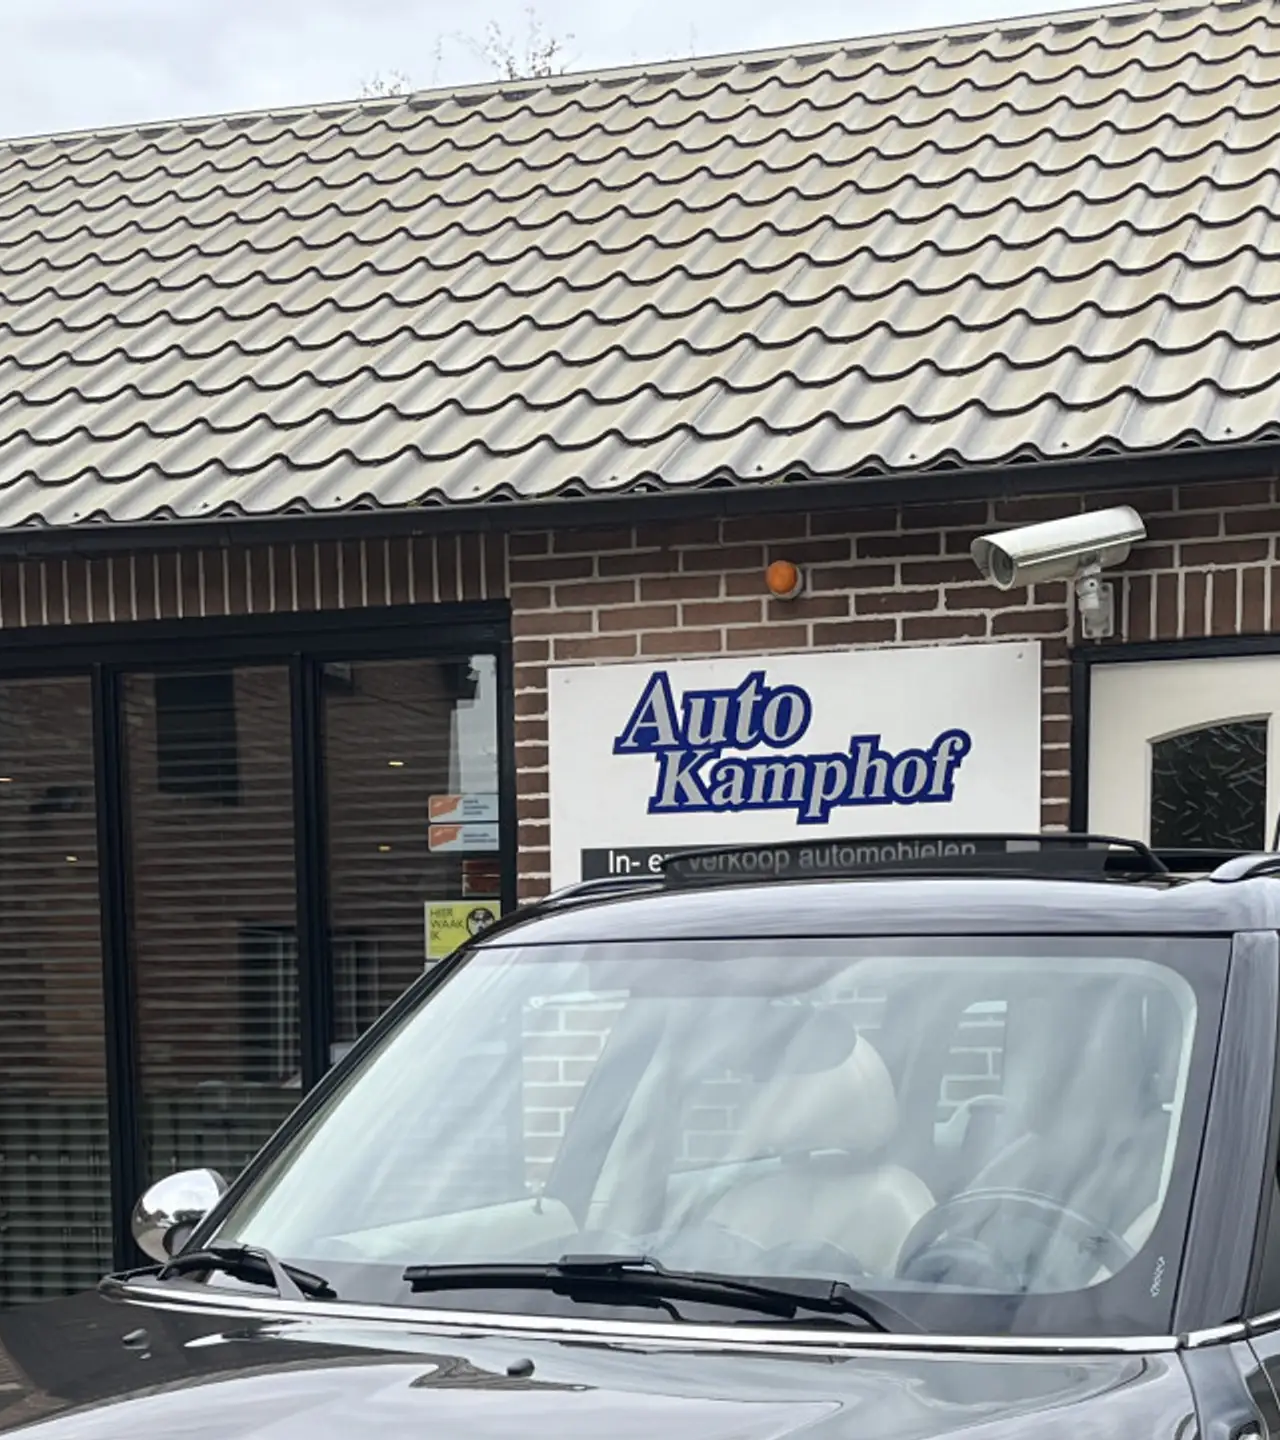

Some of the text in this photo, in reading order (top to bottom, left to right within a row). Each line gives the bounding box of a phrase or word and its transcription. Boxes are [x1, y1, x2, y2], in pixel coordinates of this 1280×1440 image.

[613, 671, 811, 754] Auto
[647, 729, 971, 824] Kamphof
[608, 850, 641, 874] In-
[688, 848, 790, 874] verkoop
[430, 920, 464, 929] WAAK
